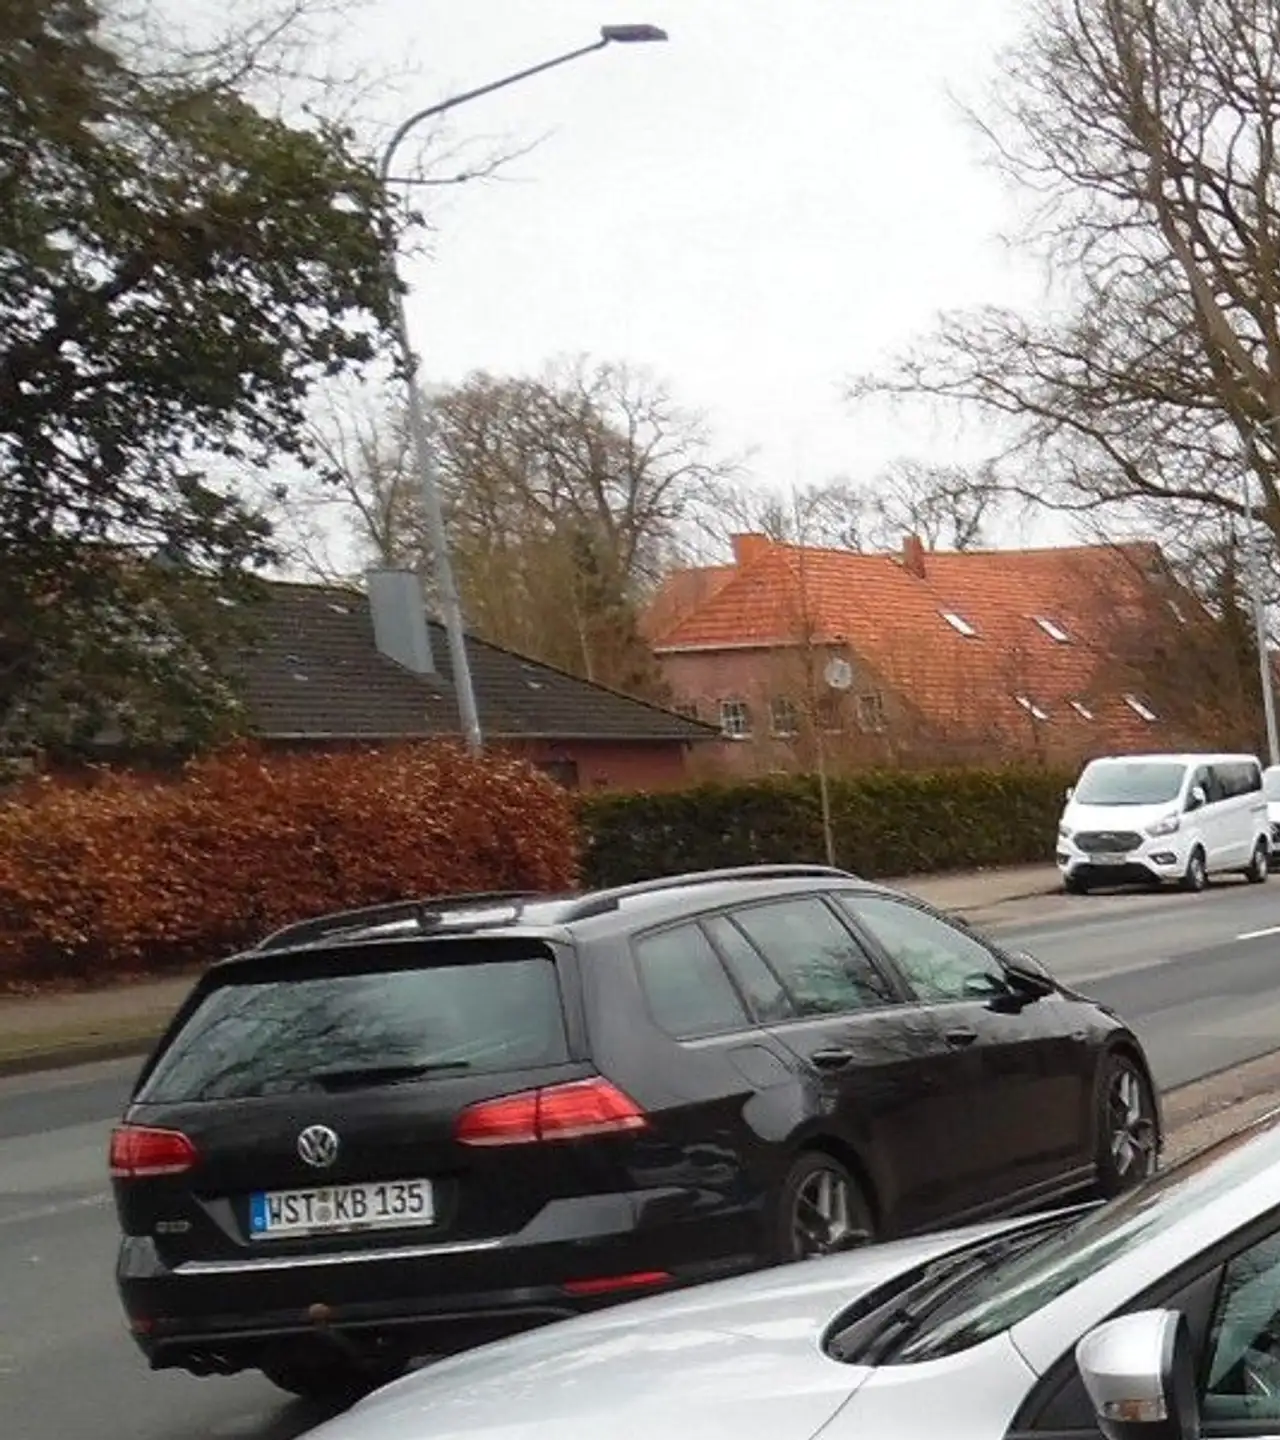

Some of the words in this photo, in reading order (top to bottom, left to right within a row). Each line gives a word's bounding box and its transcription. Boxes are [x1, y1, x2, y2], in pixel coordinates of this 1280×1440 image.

[267, 1193, 316, 1226] WST
[334, 1188, 367, 1219] KB
[374, 1183, 424, 1216] 135
